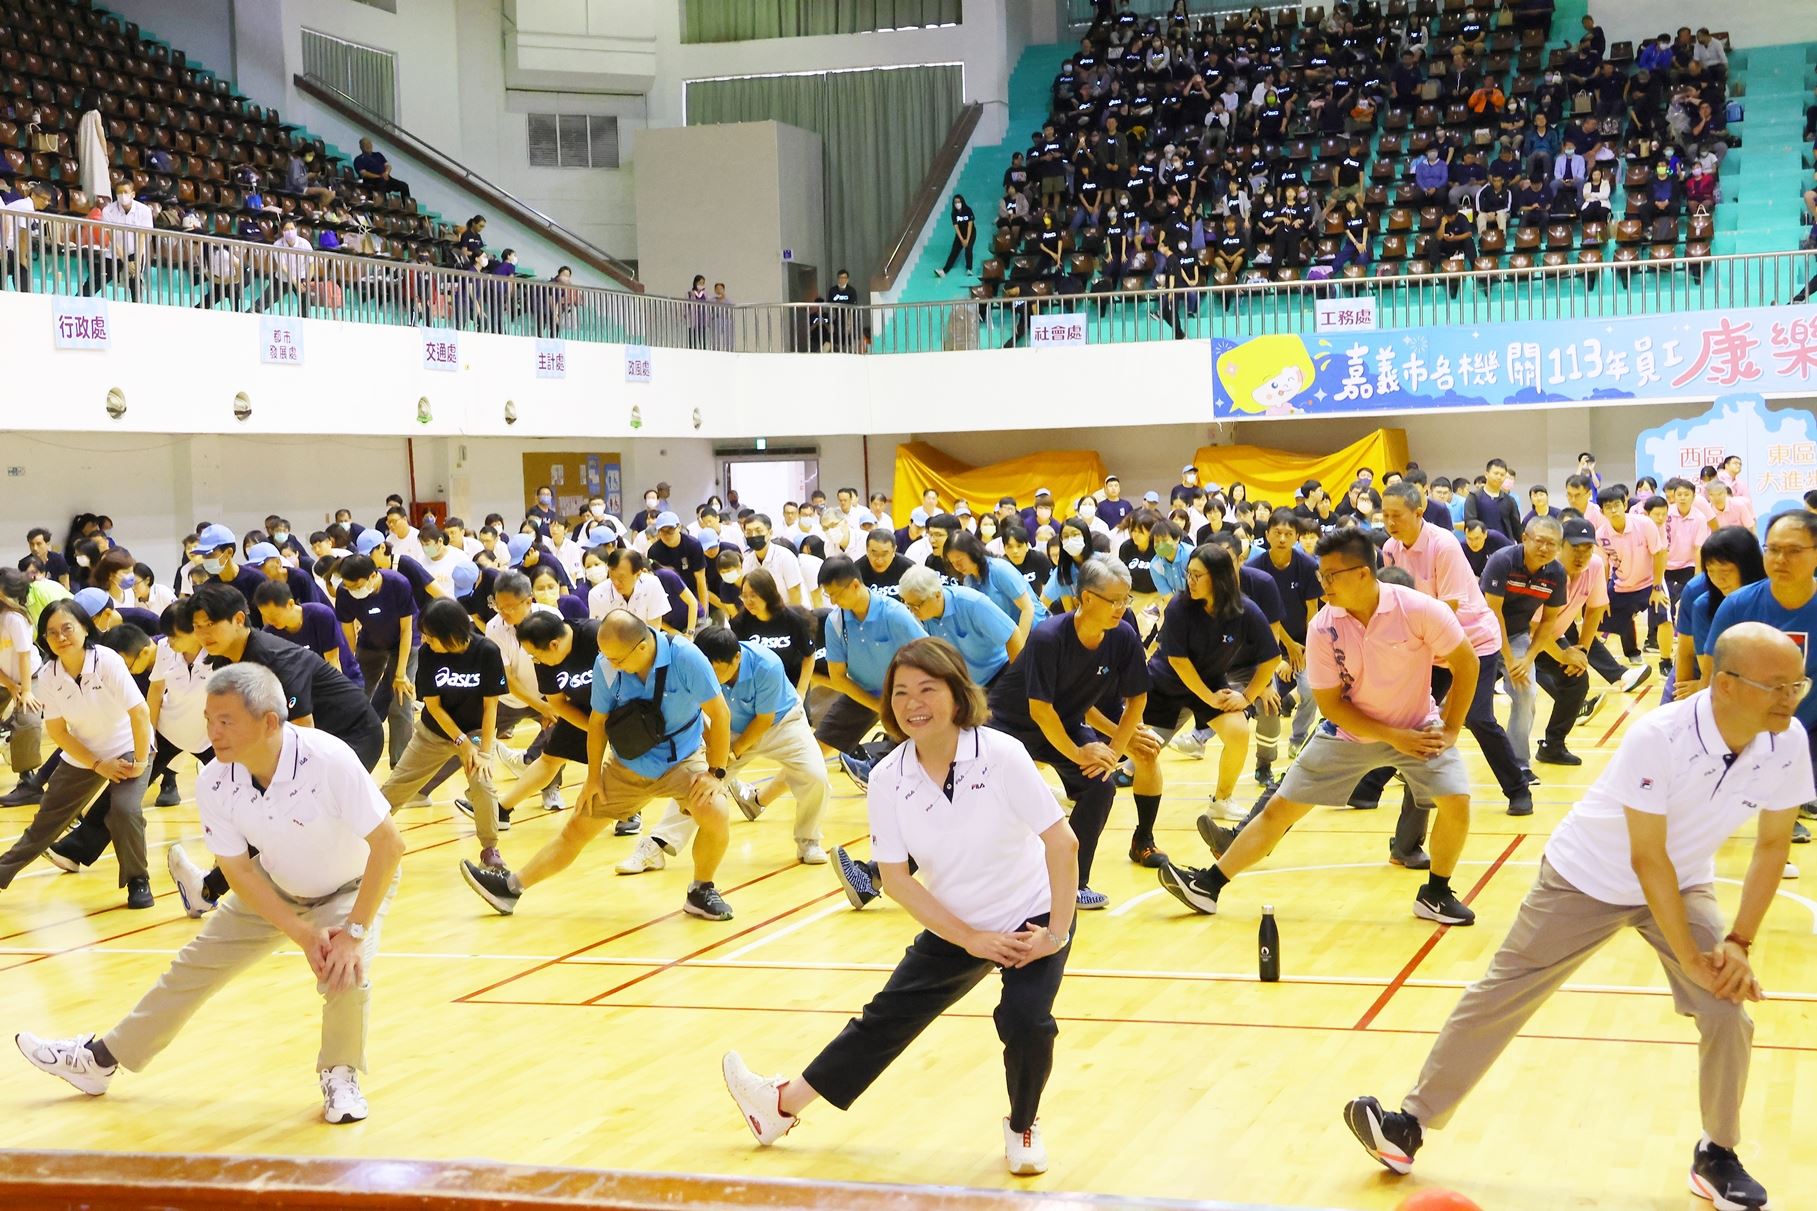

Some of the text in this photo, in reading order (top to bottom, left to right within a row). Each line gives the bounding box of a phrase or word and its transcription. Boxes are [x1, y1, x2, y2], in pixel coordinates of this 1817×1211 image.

[1320, 309, 1372, 326] 工務處
[58, 314, 107, 340] 行政處
[1034, 324, 1082, 342] 社會處
[274, 330, 291, 343] 都市
[270, 345, 297, 360] 發展處
[426, 342, 457, 363] 交通處
[538, 352, 564, 371] 主計處
[628, 360, 650, 376] 政風處
[1680, 447, 1725, 468] 西區
[1768, 443, 1815, 465] 東區
